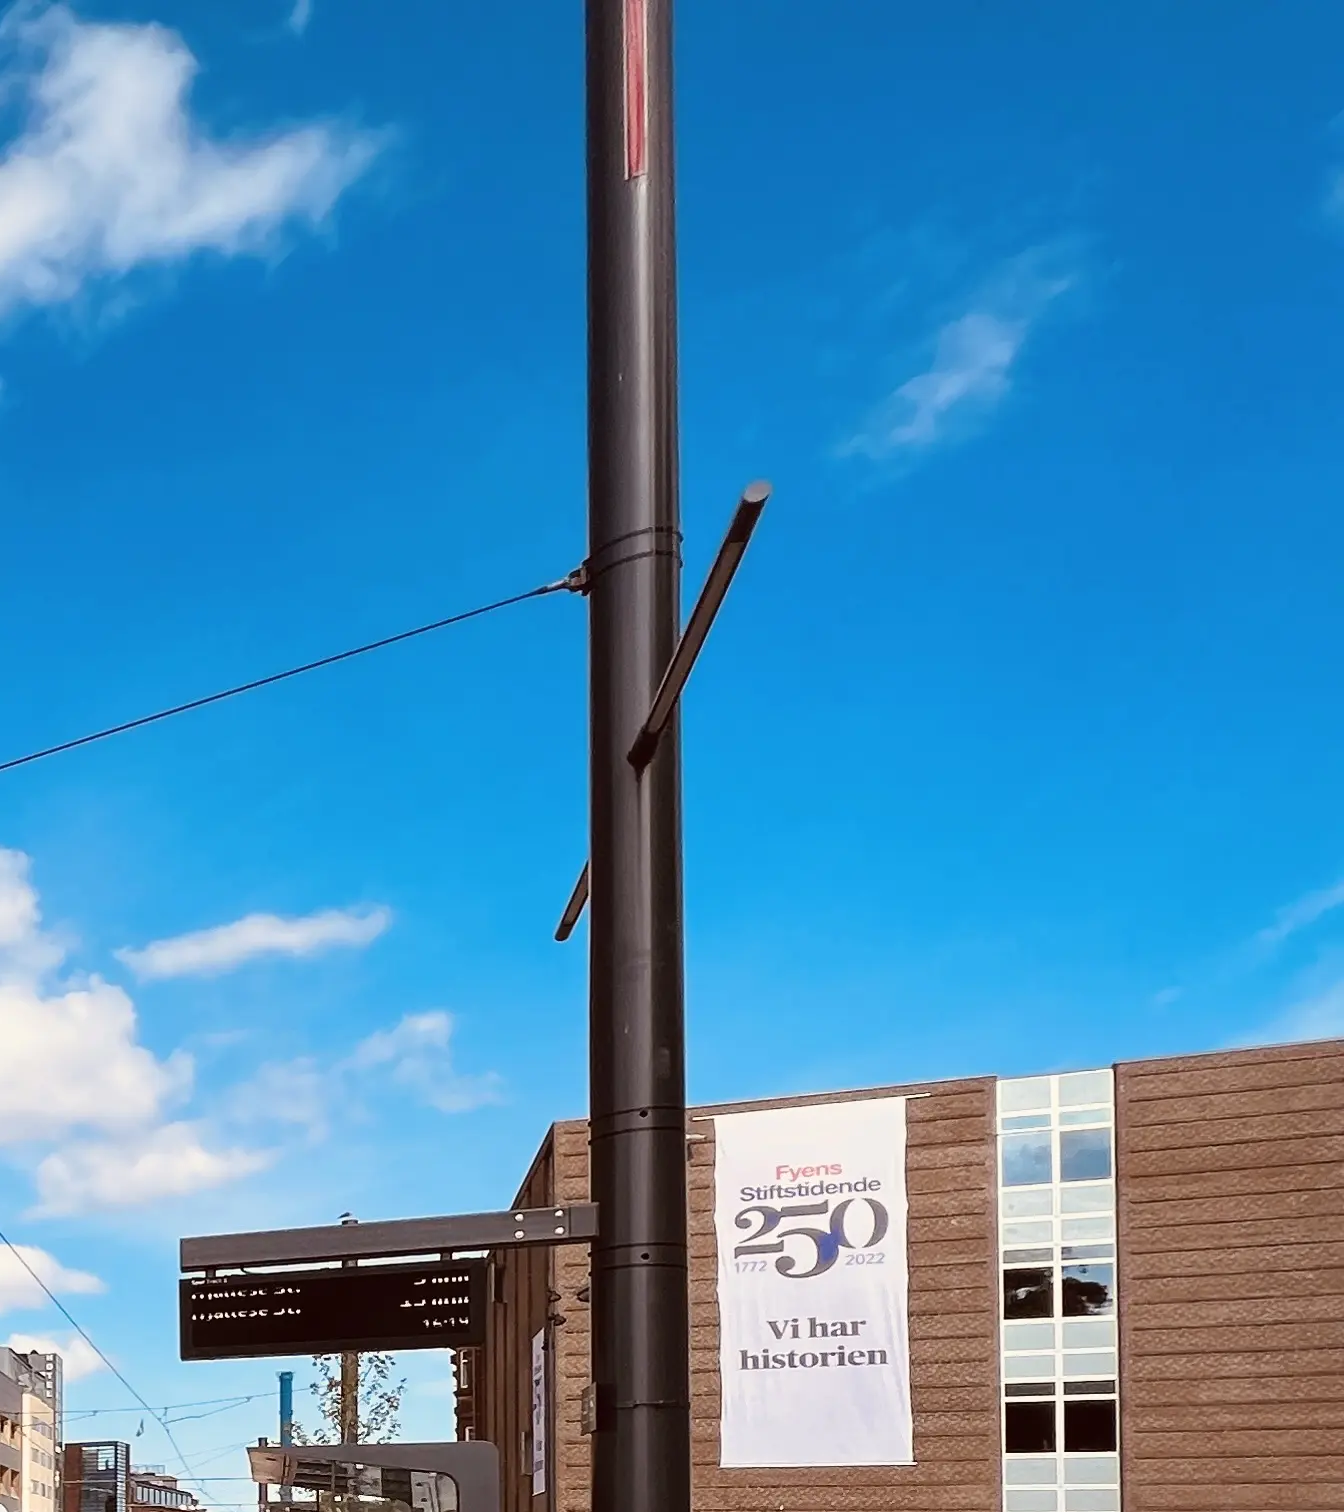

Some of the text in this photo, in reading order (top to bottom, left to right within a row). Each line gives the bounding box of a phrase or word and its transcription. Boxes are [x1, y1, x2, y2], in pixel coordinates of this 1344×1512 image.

[776, 1163, 843, 1182] Fyens
[740, 1177, 882, 1202] Stiftstidende
[734, 1198, 889, 1279] 250
[734, 1260, 768, 1274] 1772
[845, 1252, 886, 1267] 2022
[767, 1316, 867, 1340] Vi har
[739, 1344, 889, 1371] historien
[45, 1354, 54, 1398] HOTEL
